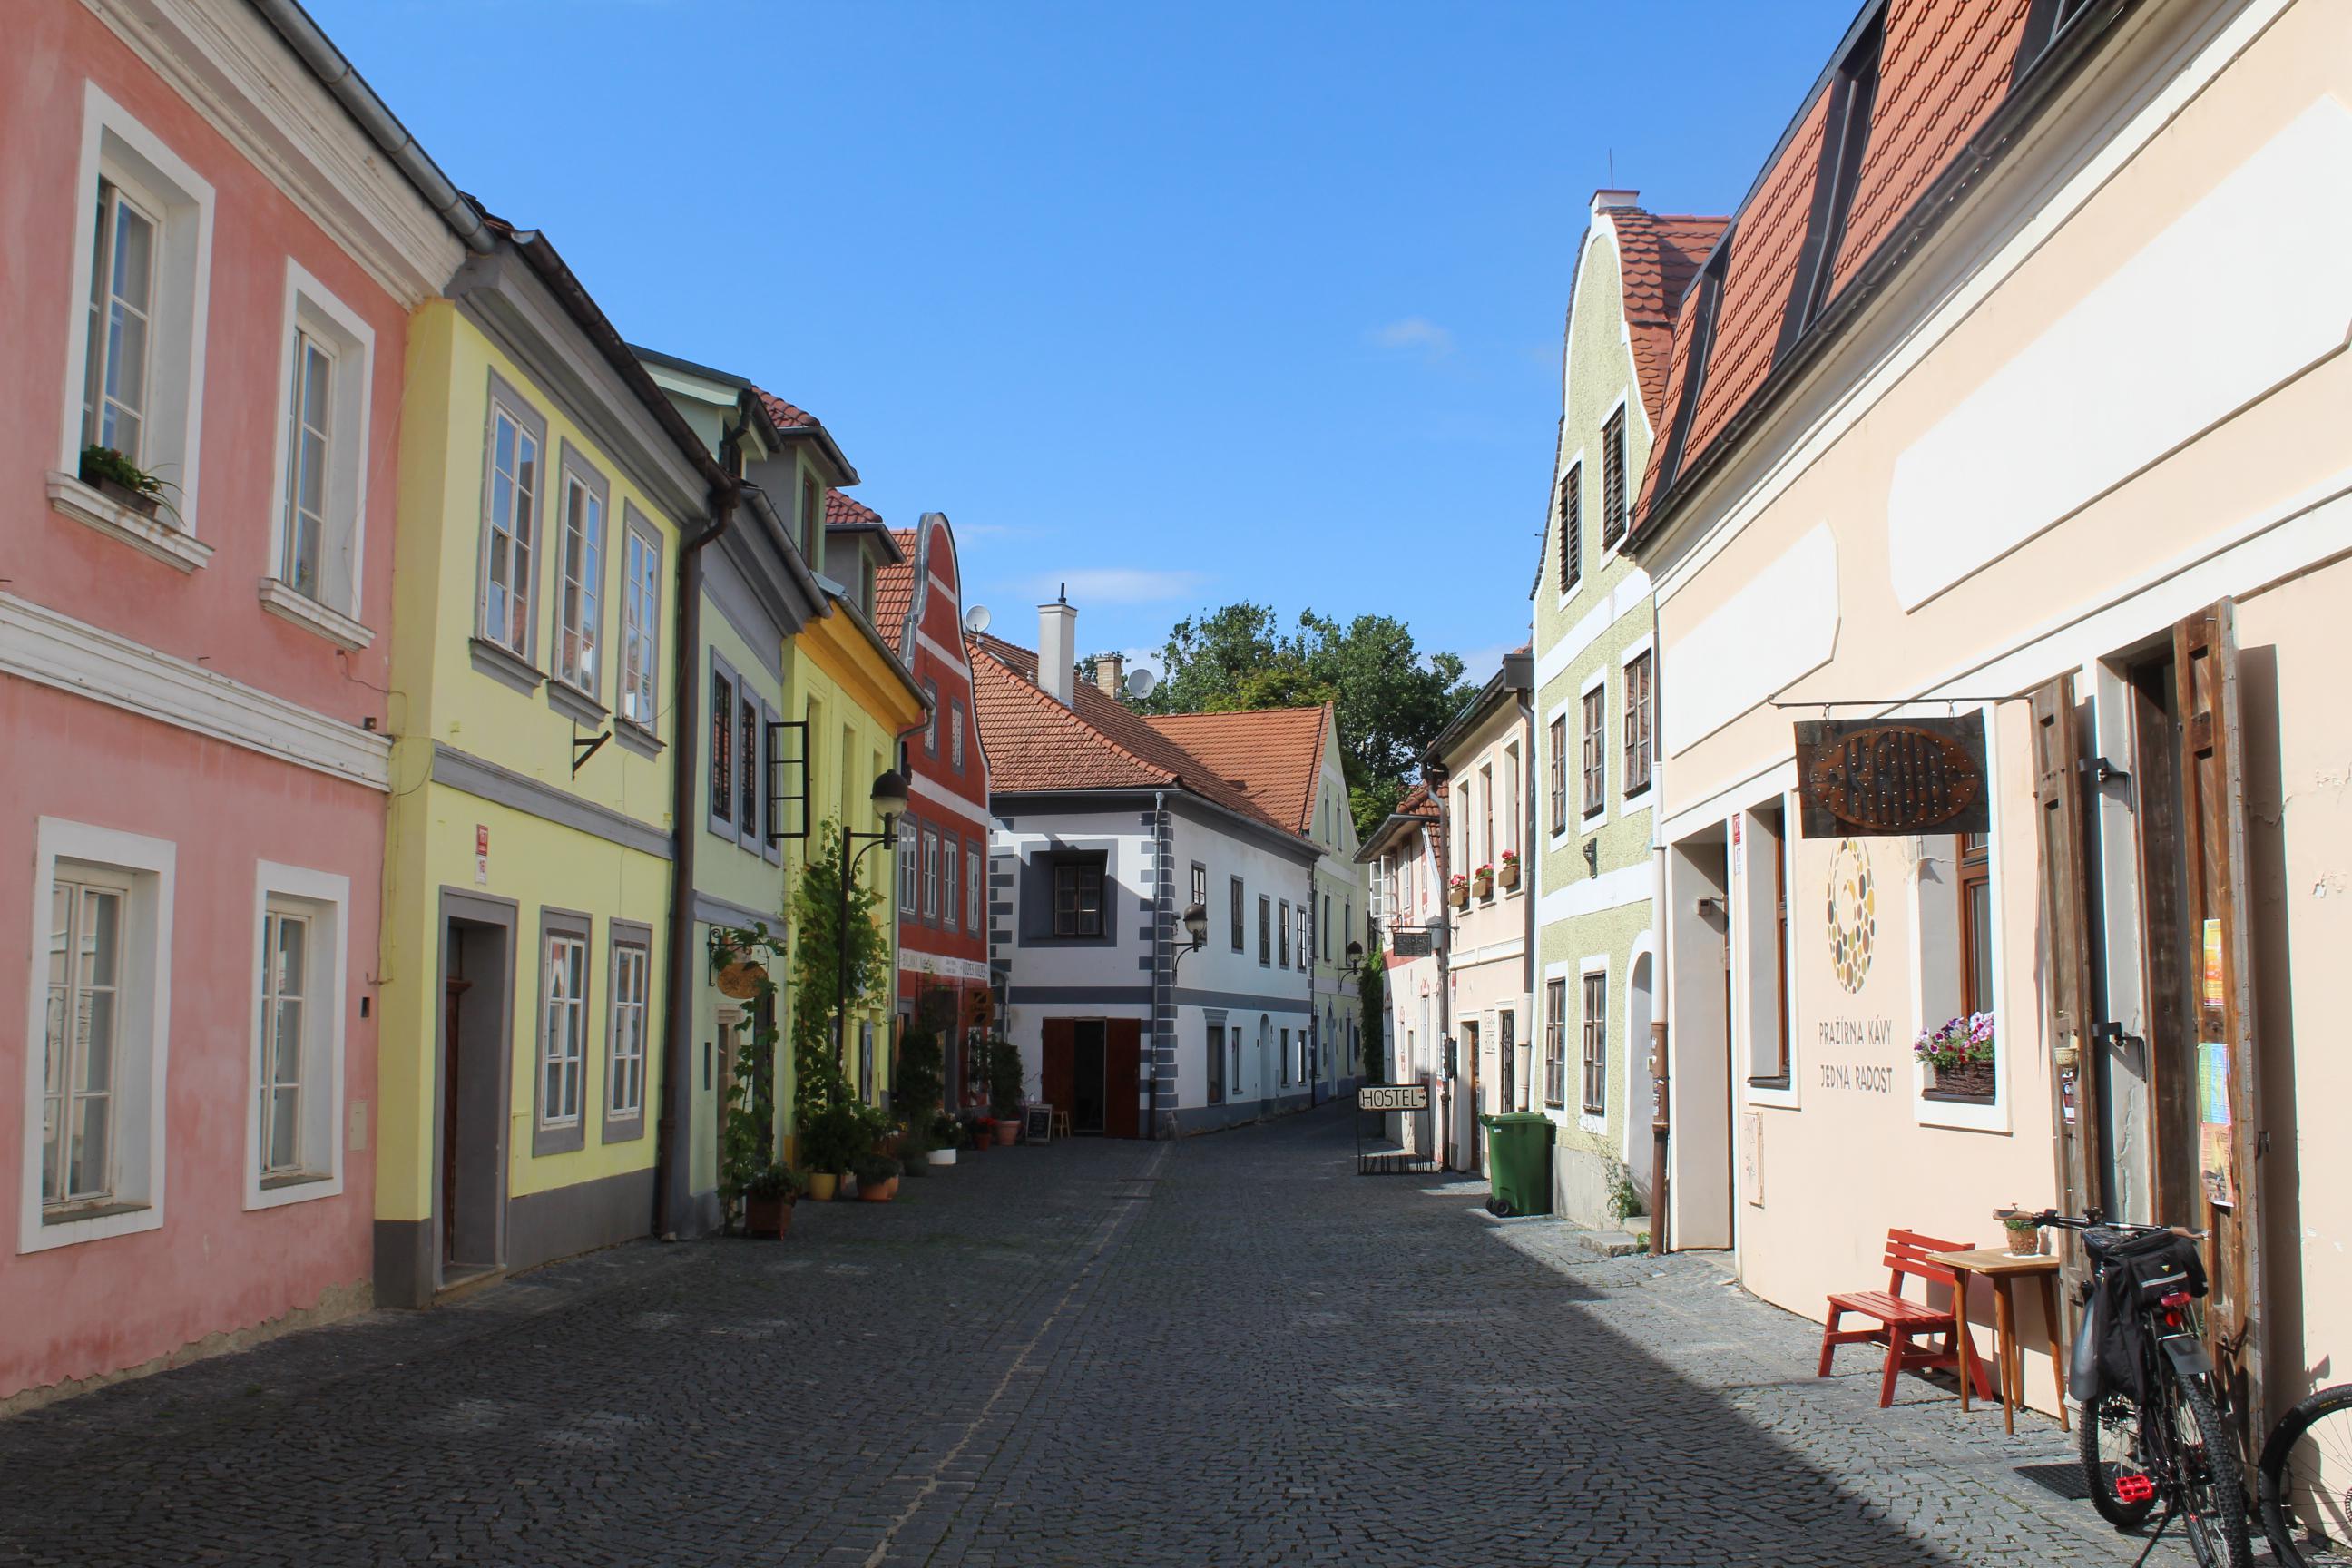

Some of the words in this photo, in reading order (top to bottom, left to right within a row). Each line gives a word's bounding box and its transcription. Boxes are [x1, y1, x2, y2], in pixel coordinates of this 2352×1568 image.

[1819, 1015, 1864, 1044] PRAŽÍRNA
[1868, 1014, 1892, 1044] KÁVY
[1820, 1064, 1851, 1089] JEDNA
[1855, 1065, 1892, 1093] RADOST
[1362, 1089, 1418, 1107] HOSTEL
